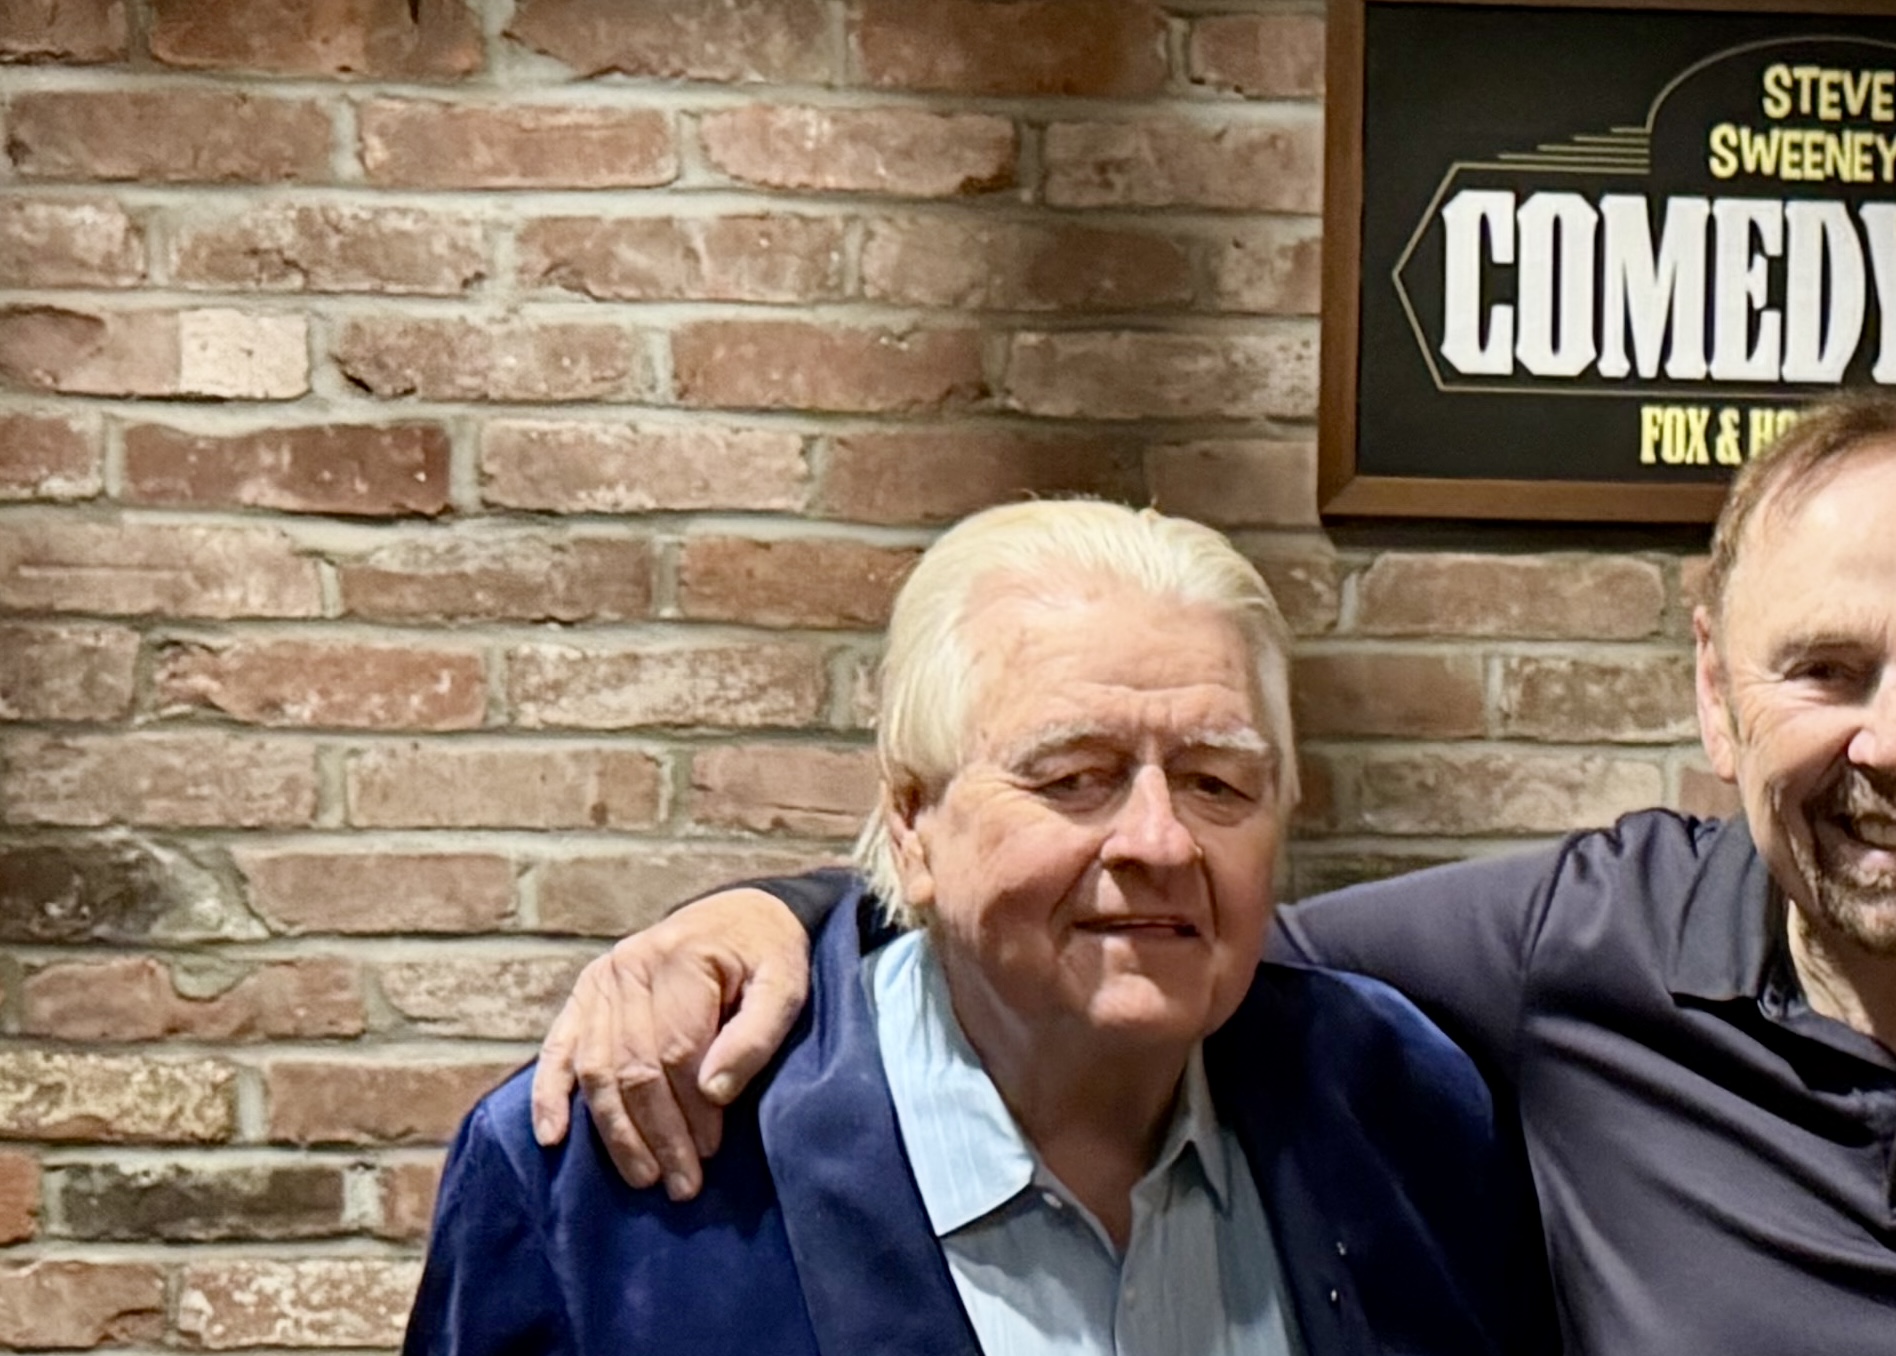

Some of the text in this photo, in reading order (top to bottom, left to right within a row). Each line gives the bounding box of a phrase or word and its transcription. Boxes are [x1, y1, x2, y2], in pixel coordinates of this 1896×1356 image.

[1761, 63, 1896, 122] STEVE
[1640, 405, 1711, 465] FOX
[1714, 407, 1743, 465] &
